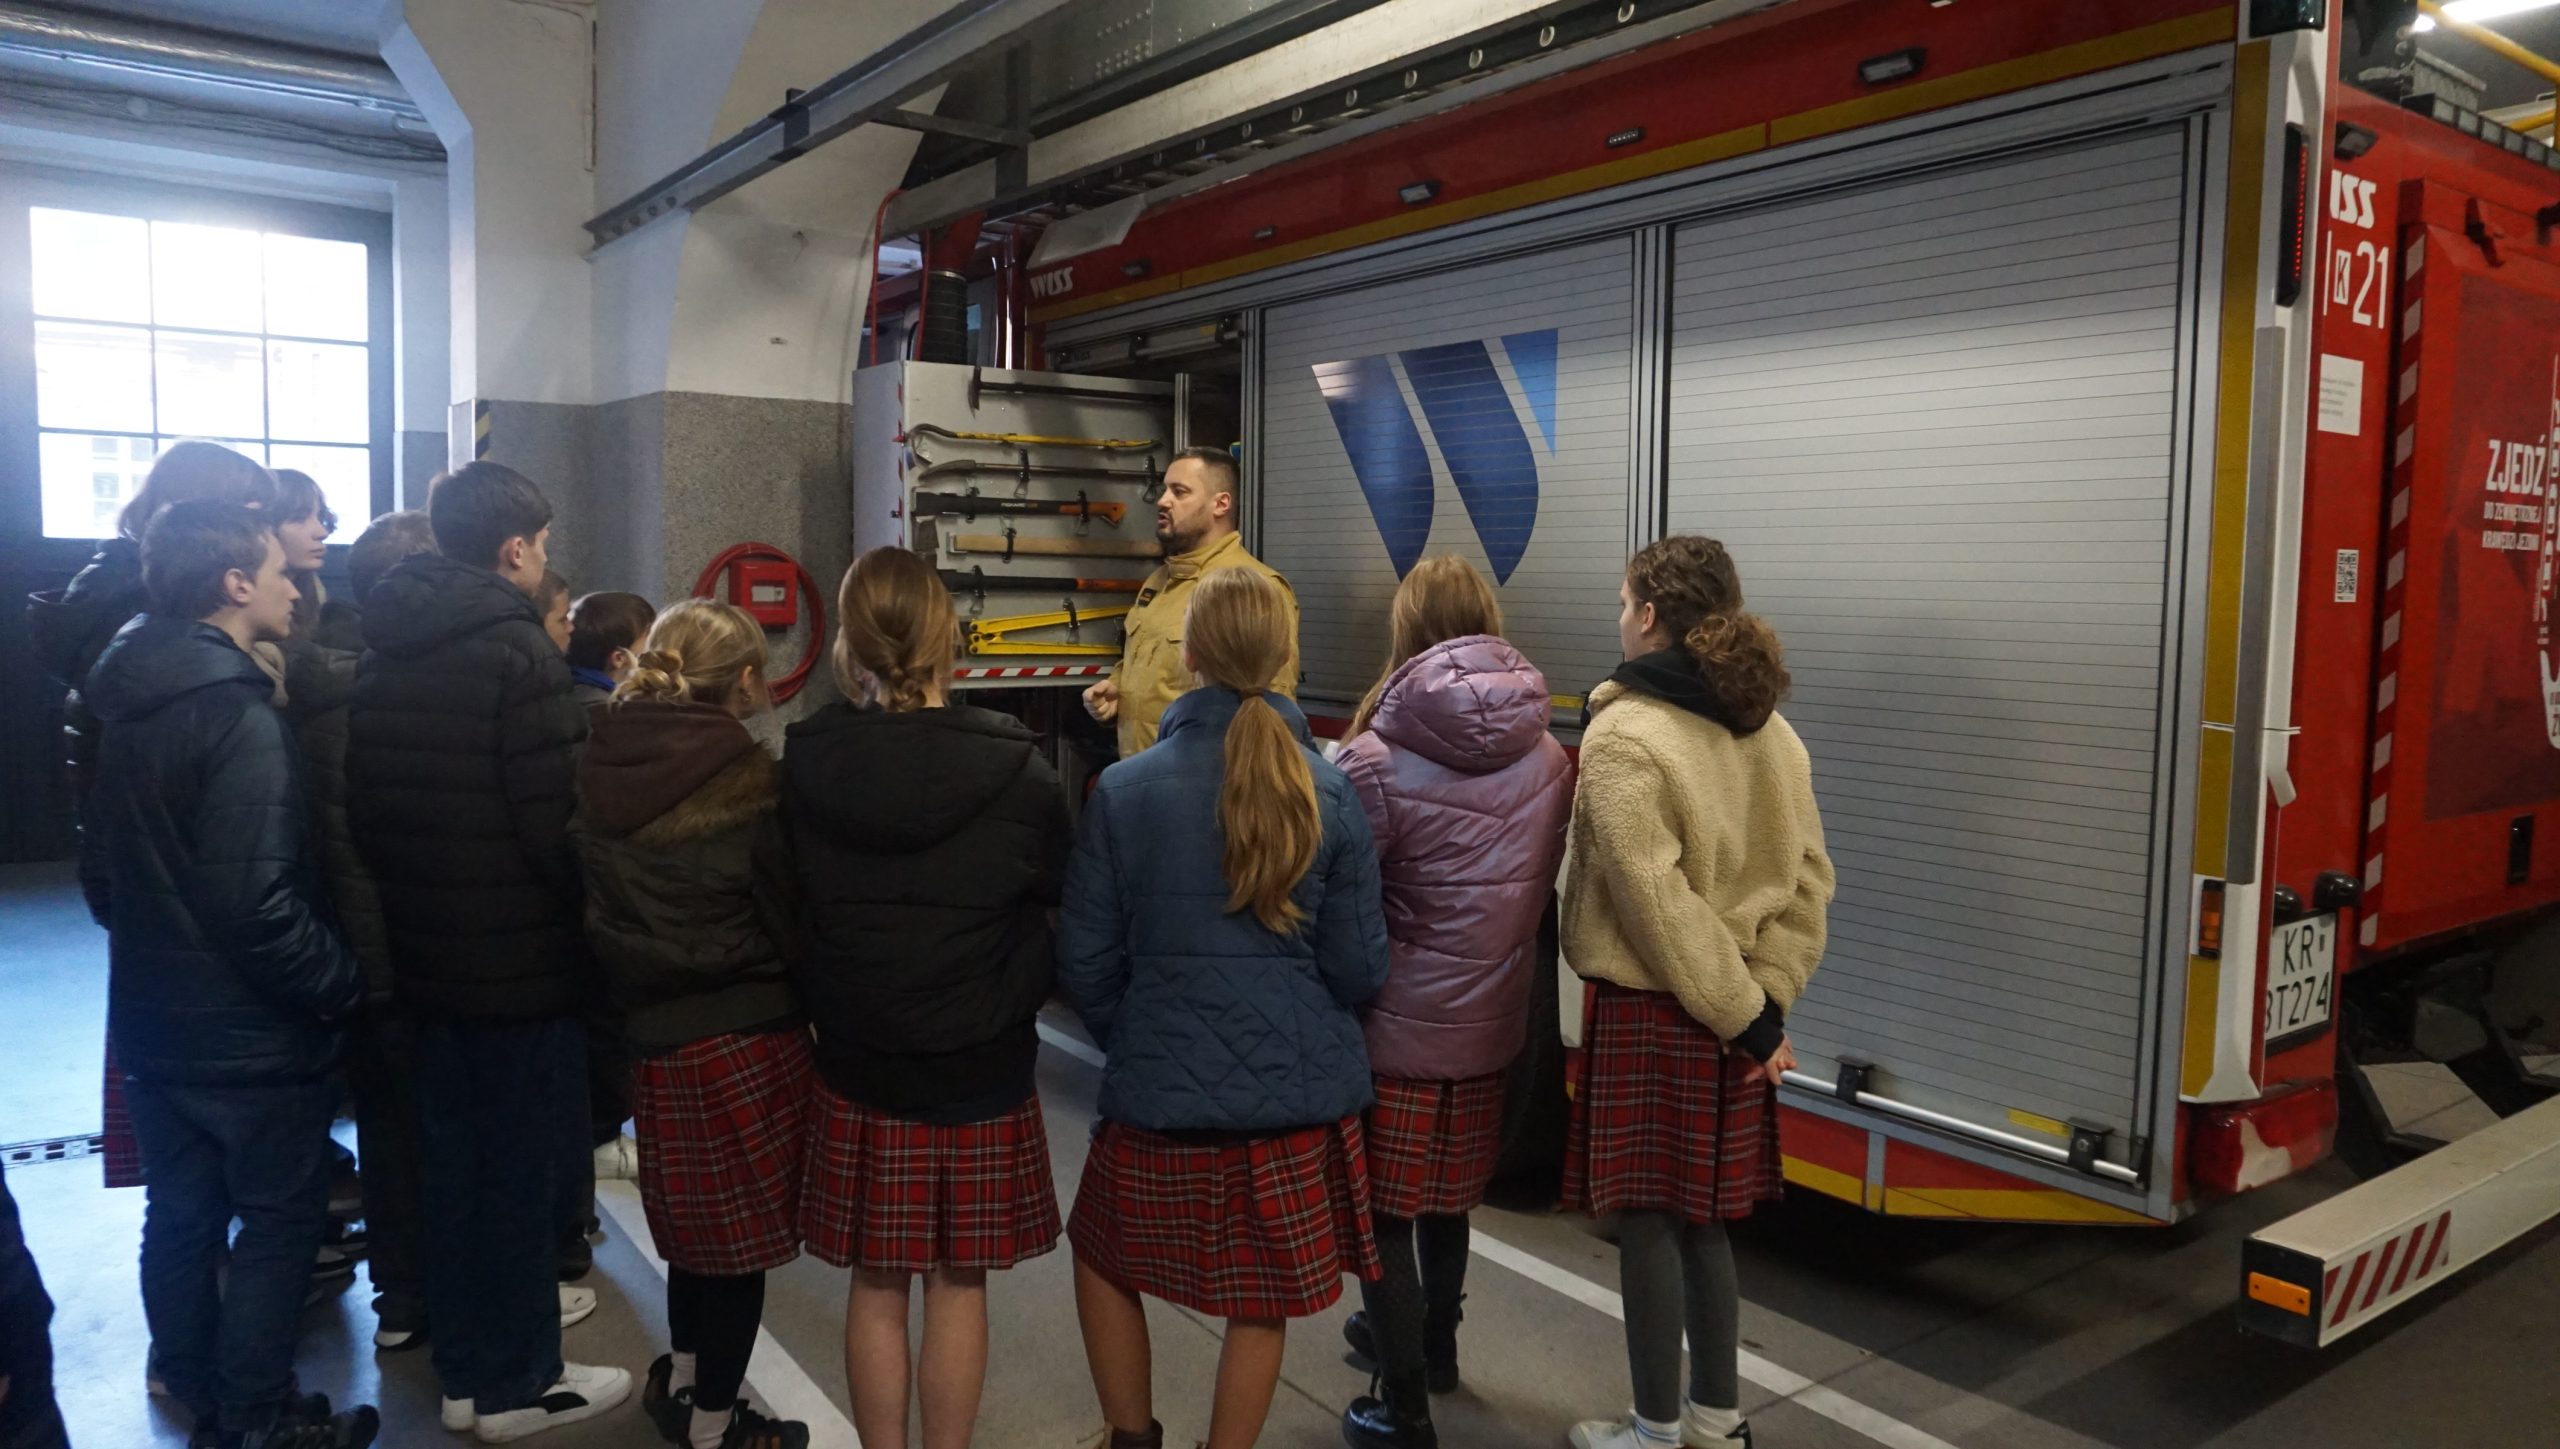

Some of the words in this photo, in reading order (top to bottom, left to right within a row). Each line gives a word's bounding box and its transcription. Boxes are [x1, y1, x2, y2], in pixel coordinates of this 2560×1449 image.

[2329, 169, 2377, 229] ISS
[1029, 266, 1073, 298] WISS
[2485, 434, 2546, 496] ZJEDŹ
[2283, 924, 2314, 976] KR
